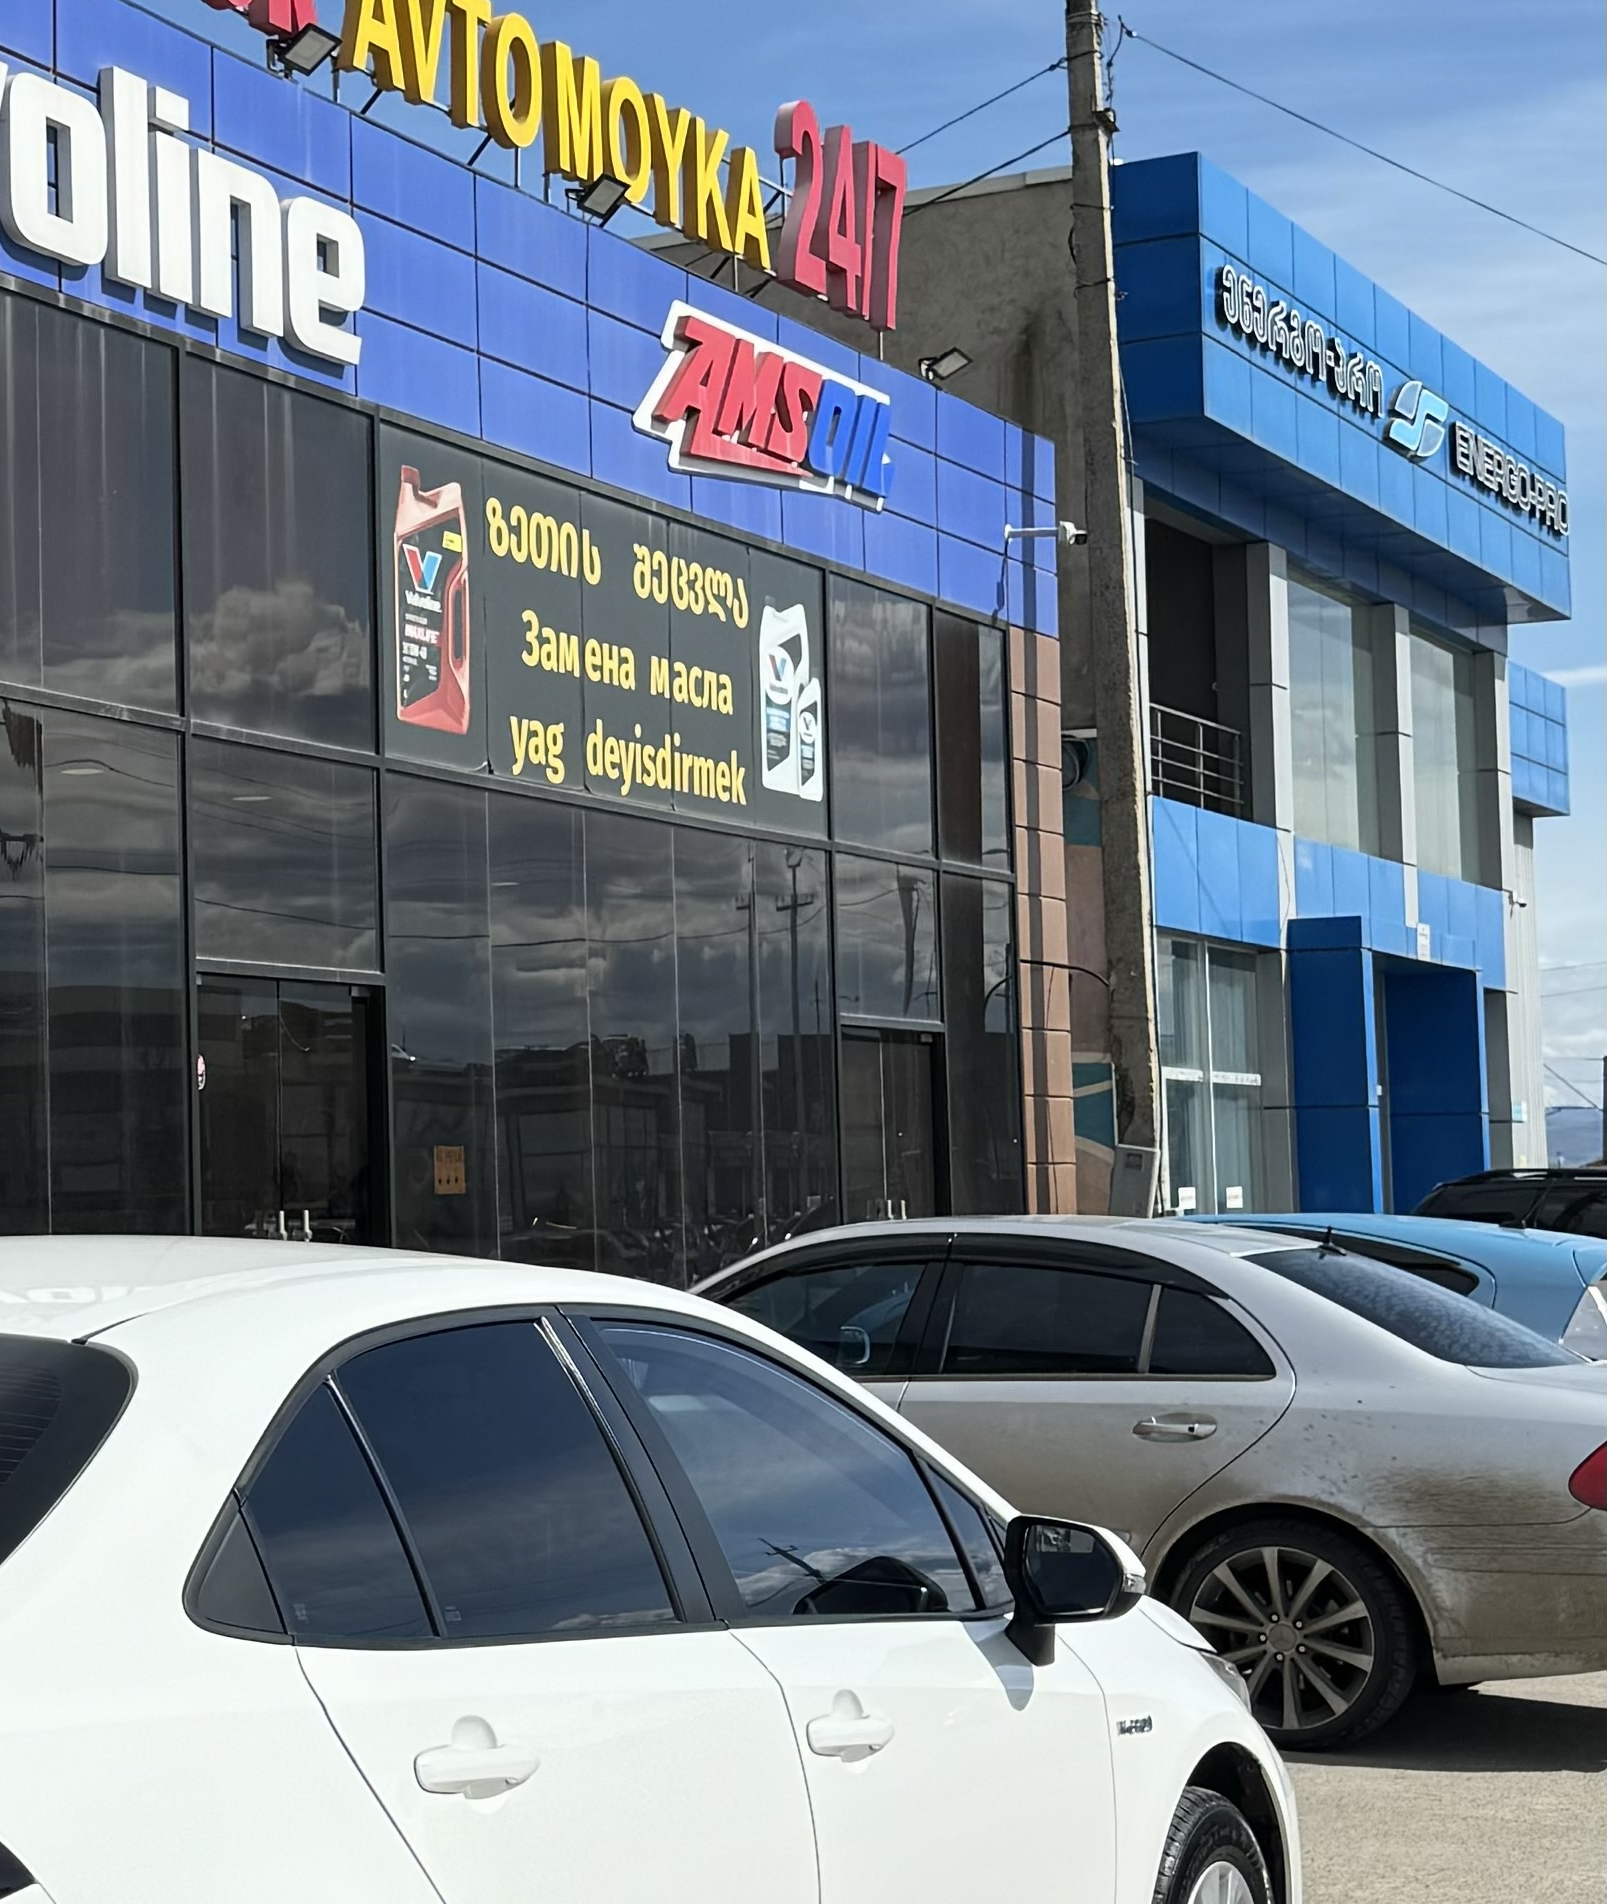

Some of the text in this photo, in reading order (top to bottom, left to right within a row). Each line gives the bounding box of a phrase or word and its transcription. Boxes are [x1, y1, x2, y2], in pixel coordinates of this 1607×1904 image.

[774, 99, 906, 330] 24/7
[651, 315, 894, 497] AMSOIL
[1454, 420, 1570, 536] ENERGO-PRO
[485, 496, 749, 629] ზეთის შეცვლა
[521, 609, 734, 716] Замена масла
[509, 715, 747, 805] yag deyisdirmek
